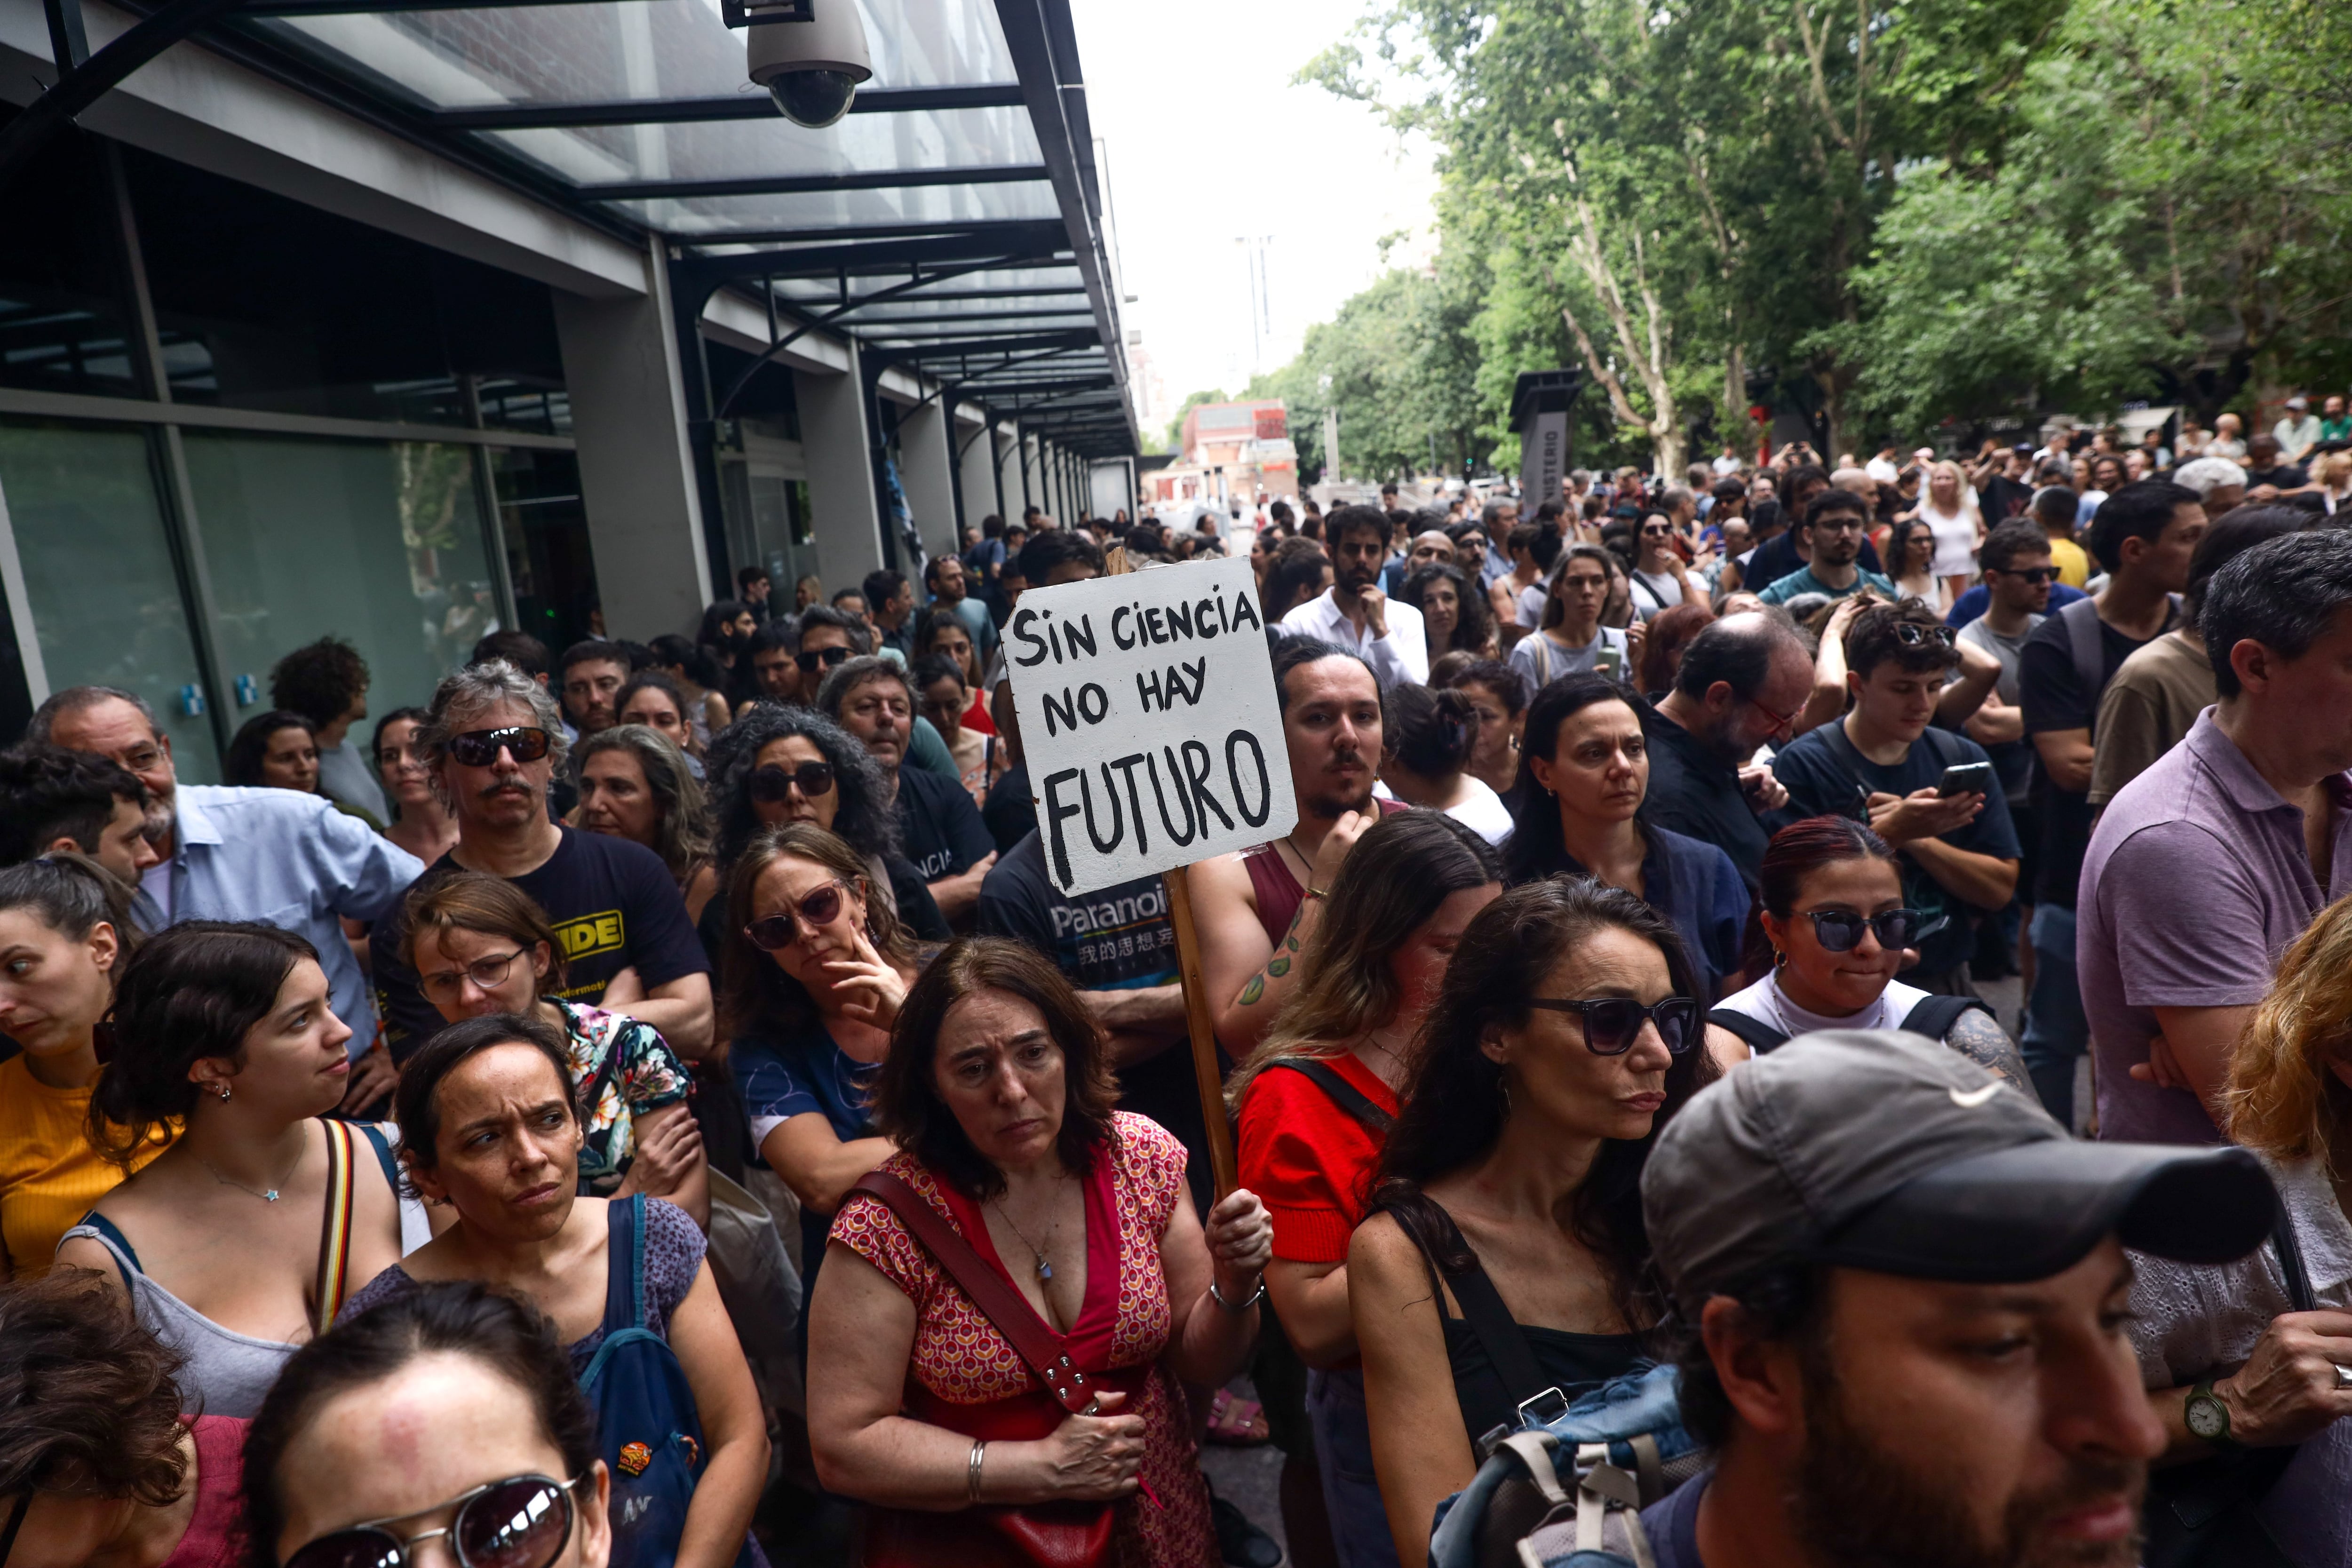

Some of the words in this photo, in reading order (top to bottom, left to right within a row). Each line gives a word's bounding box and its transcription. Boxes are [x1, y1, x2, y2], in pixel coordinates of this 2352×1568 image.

[1042, 683, 1109, 737] NO
[1136, 656, 1206, 712] HAY
[1044, 729, 1271, 891] FUTURO
[555, 917, 620, 955] IDE
